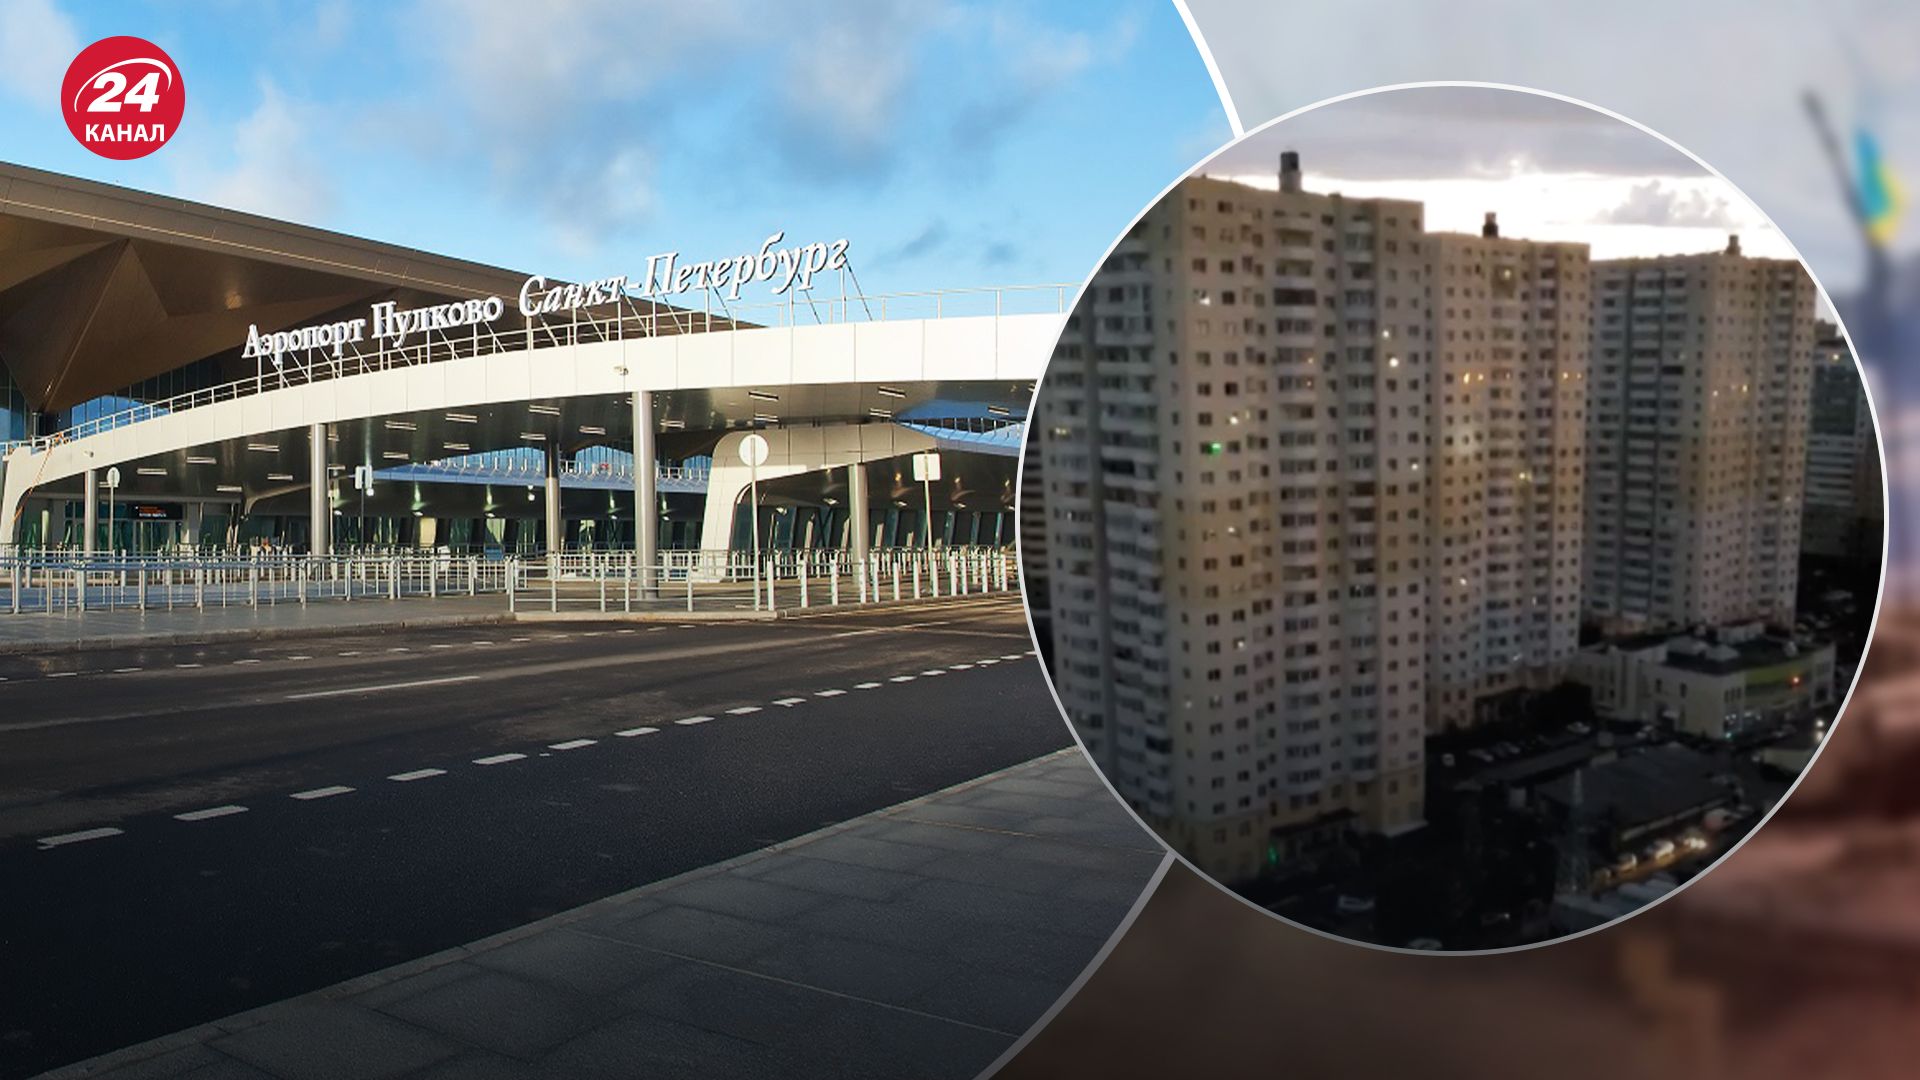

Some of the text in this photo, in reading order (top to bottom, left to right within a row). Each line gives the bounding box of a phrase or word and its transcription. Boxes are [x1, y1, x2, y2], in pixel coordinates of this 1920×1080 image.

[241, 231, 849, 365] Аэропорт Пулково Санкт-Петербург
